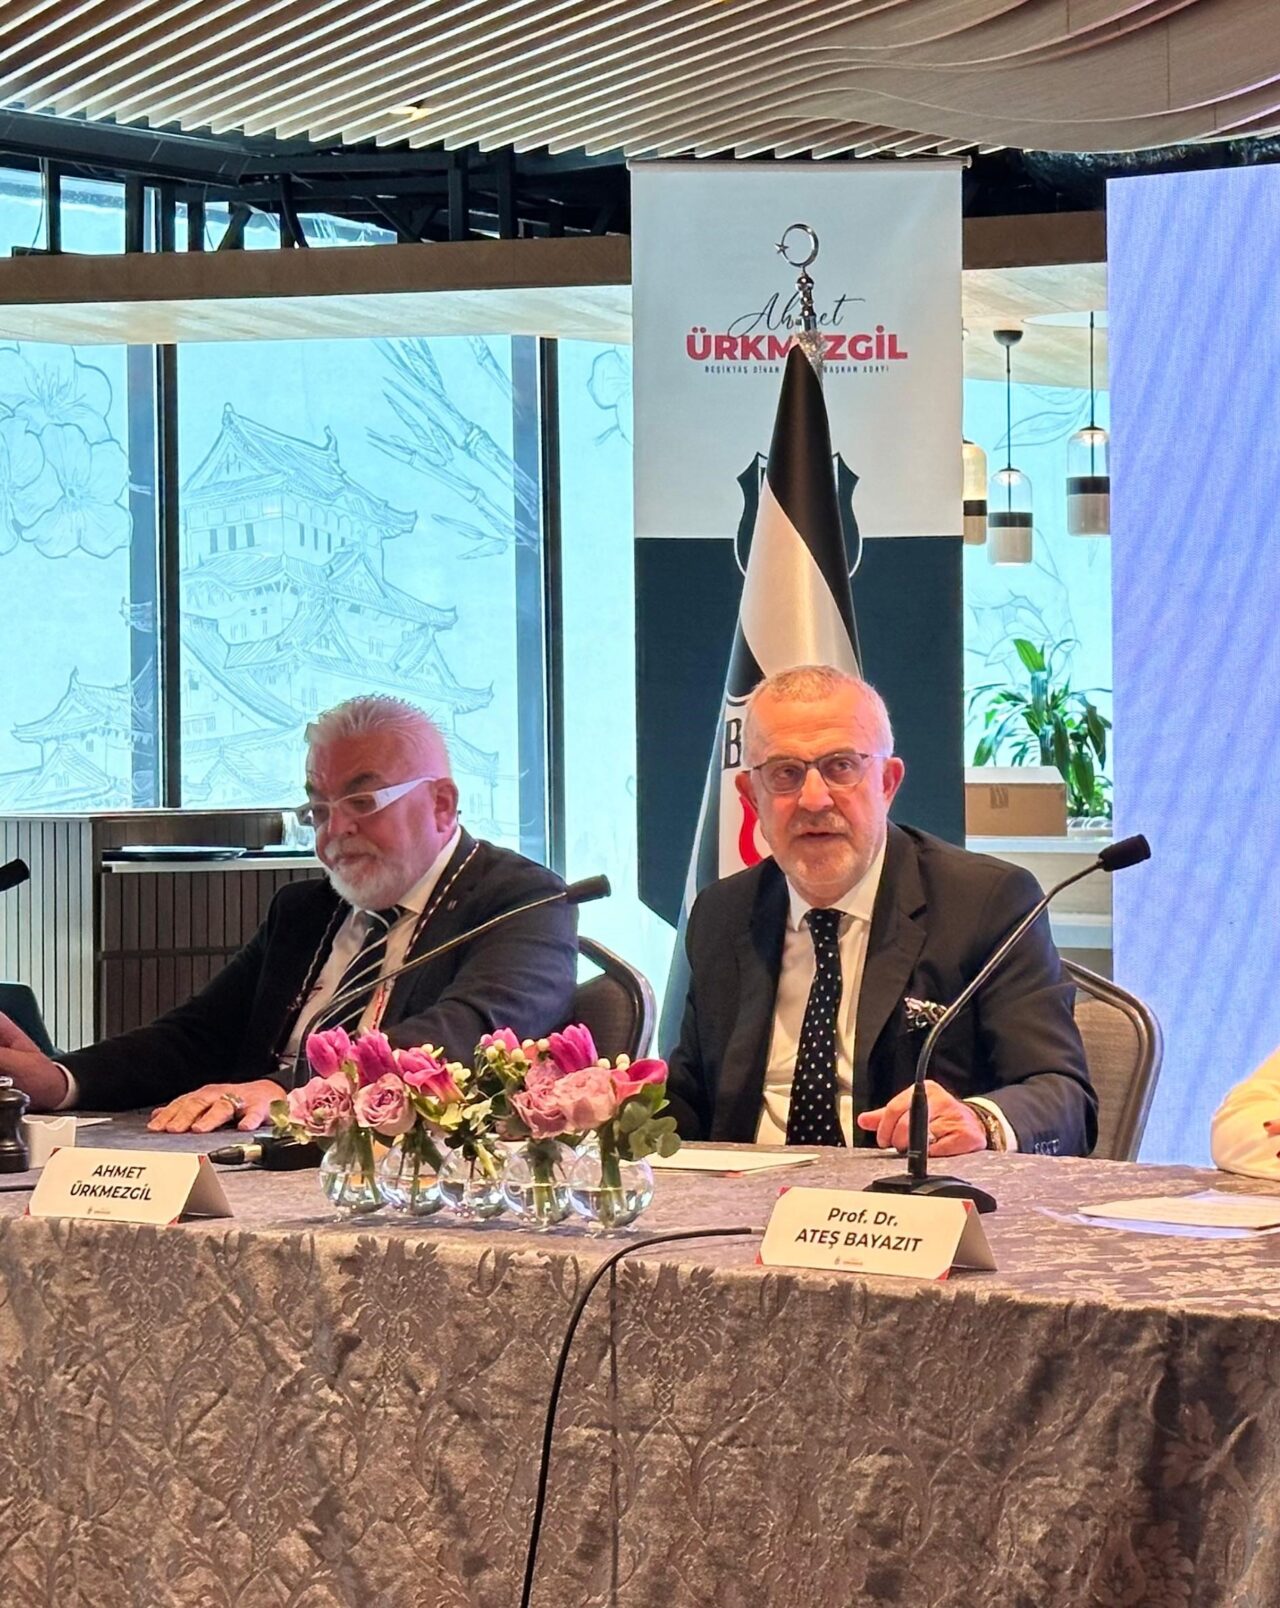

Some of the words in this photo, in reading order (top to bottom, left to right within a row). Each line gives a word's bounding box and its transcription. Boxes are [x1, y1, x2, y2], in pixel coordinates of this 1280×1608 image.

[728, 292, 866, 339] Ahet
[686, 325, 909, 361] ÜRKMZGİL
[91, 1164, 147, 1179] AHMET
[827, 1207, 868, 1224] Prof.
[873, 1210, 899, 1226] Dr.
[795, 1229, 841, 1249] ATEŞ
[844, 1231, 922, 1252] BAYAZIT
